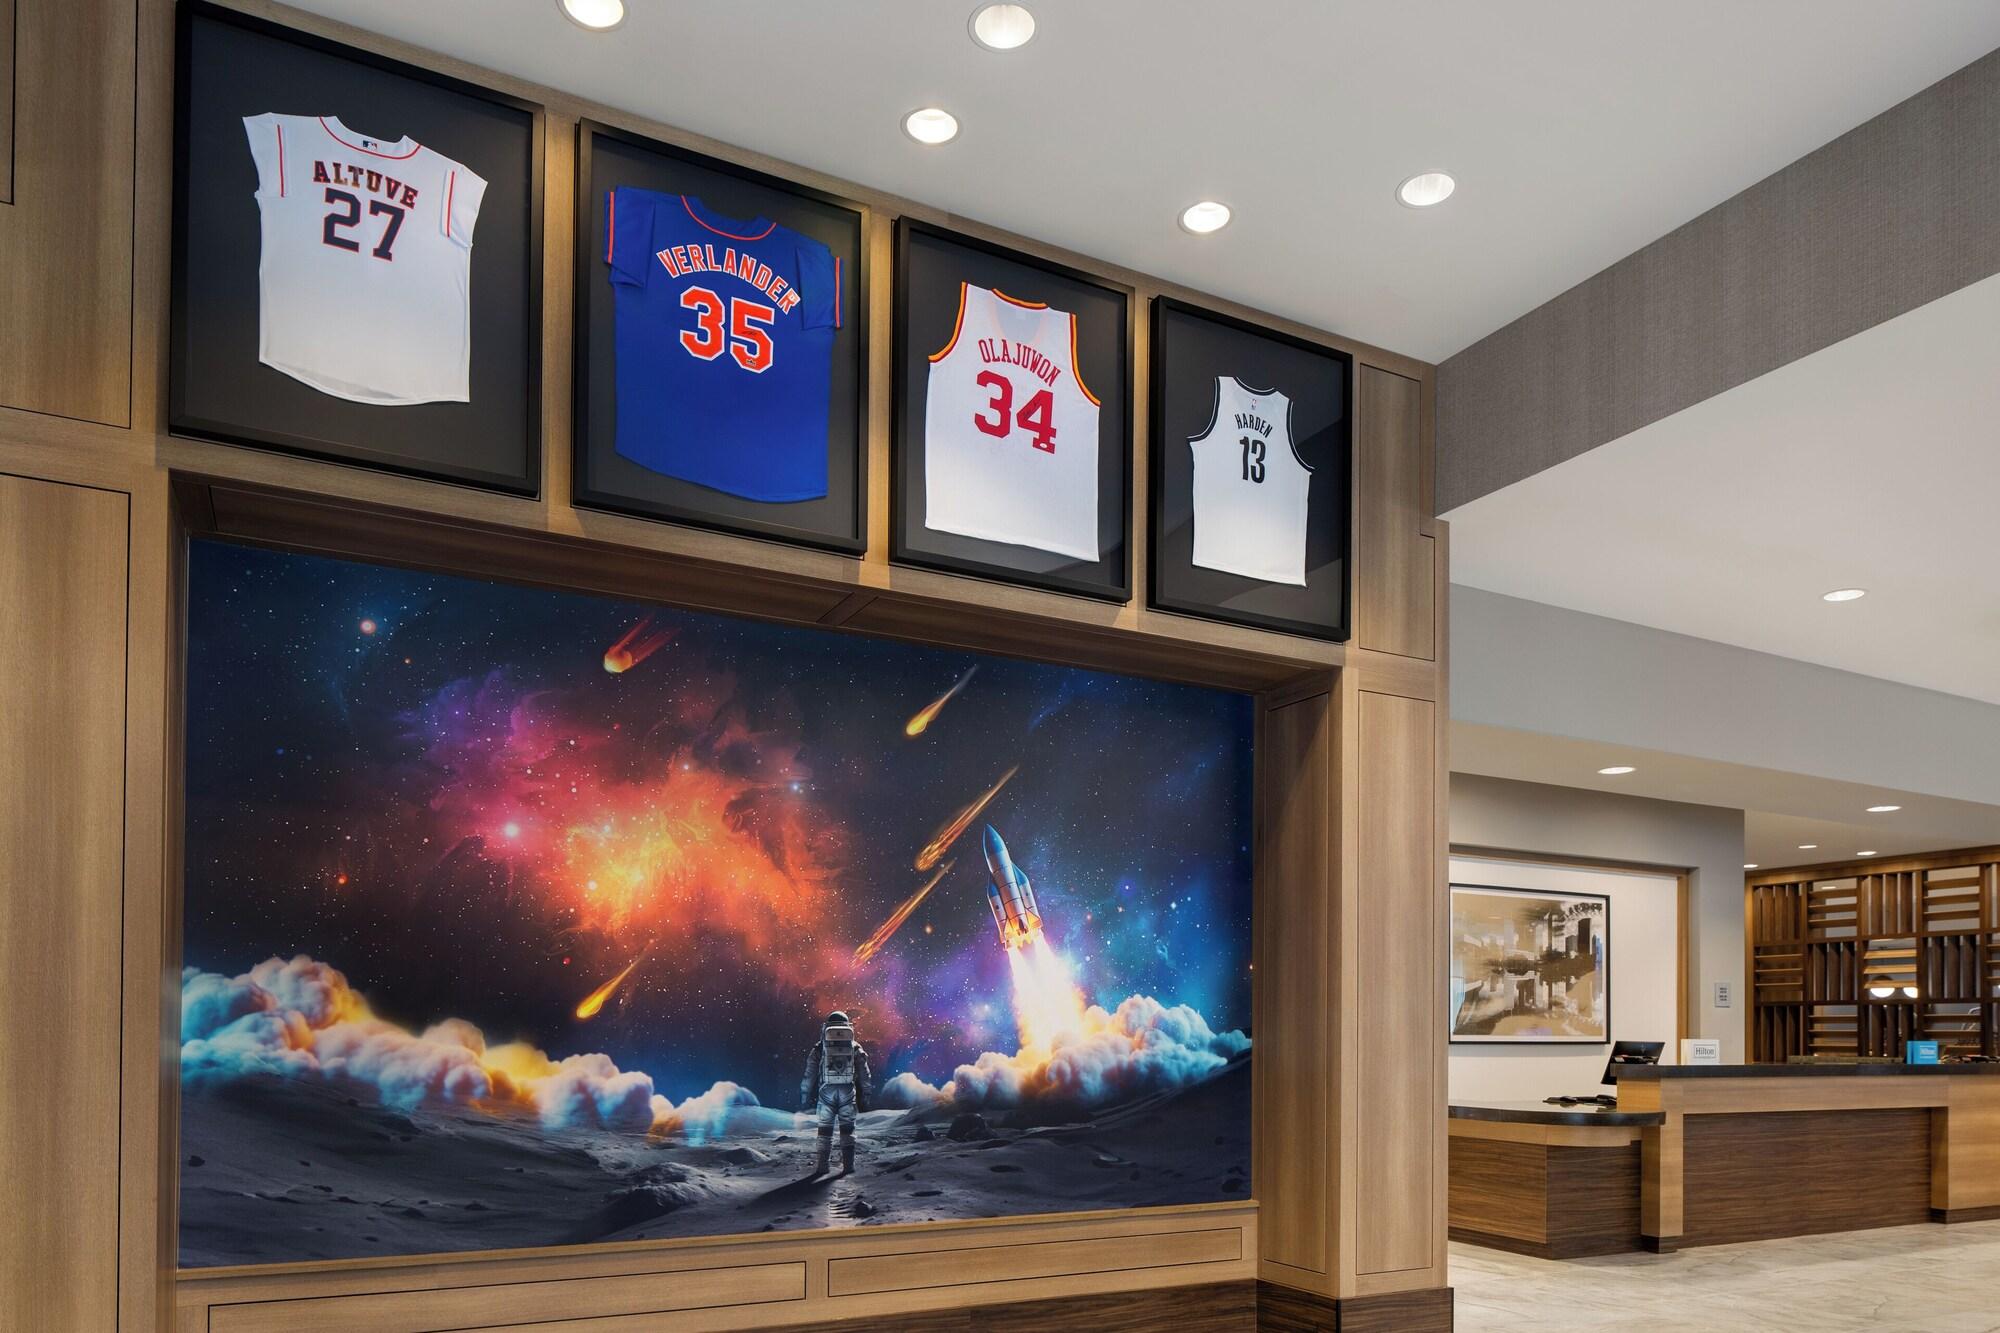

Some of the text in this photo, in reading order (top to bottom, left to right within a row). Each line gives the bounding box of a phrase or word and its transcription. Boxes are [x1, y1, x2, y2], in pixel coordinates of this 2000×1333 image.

[313, 160, 419, 210] ALTUVE
[322, 187, 406, 262] 27
[656, 244, 801, 315] VERLANDER
[680, 285, 775, 374] 35
[977, 338, 1062, 387] OLAJUWON
[974, 369, 1057, 454] 34
[1234, 413, 1273, 438] HARDEN
[1239, 436, 1266, 484] 13
[1695, 1047, 1714, 1056] Hilton
